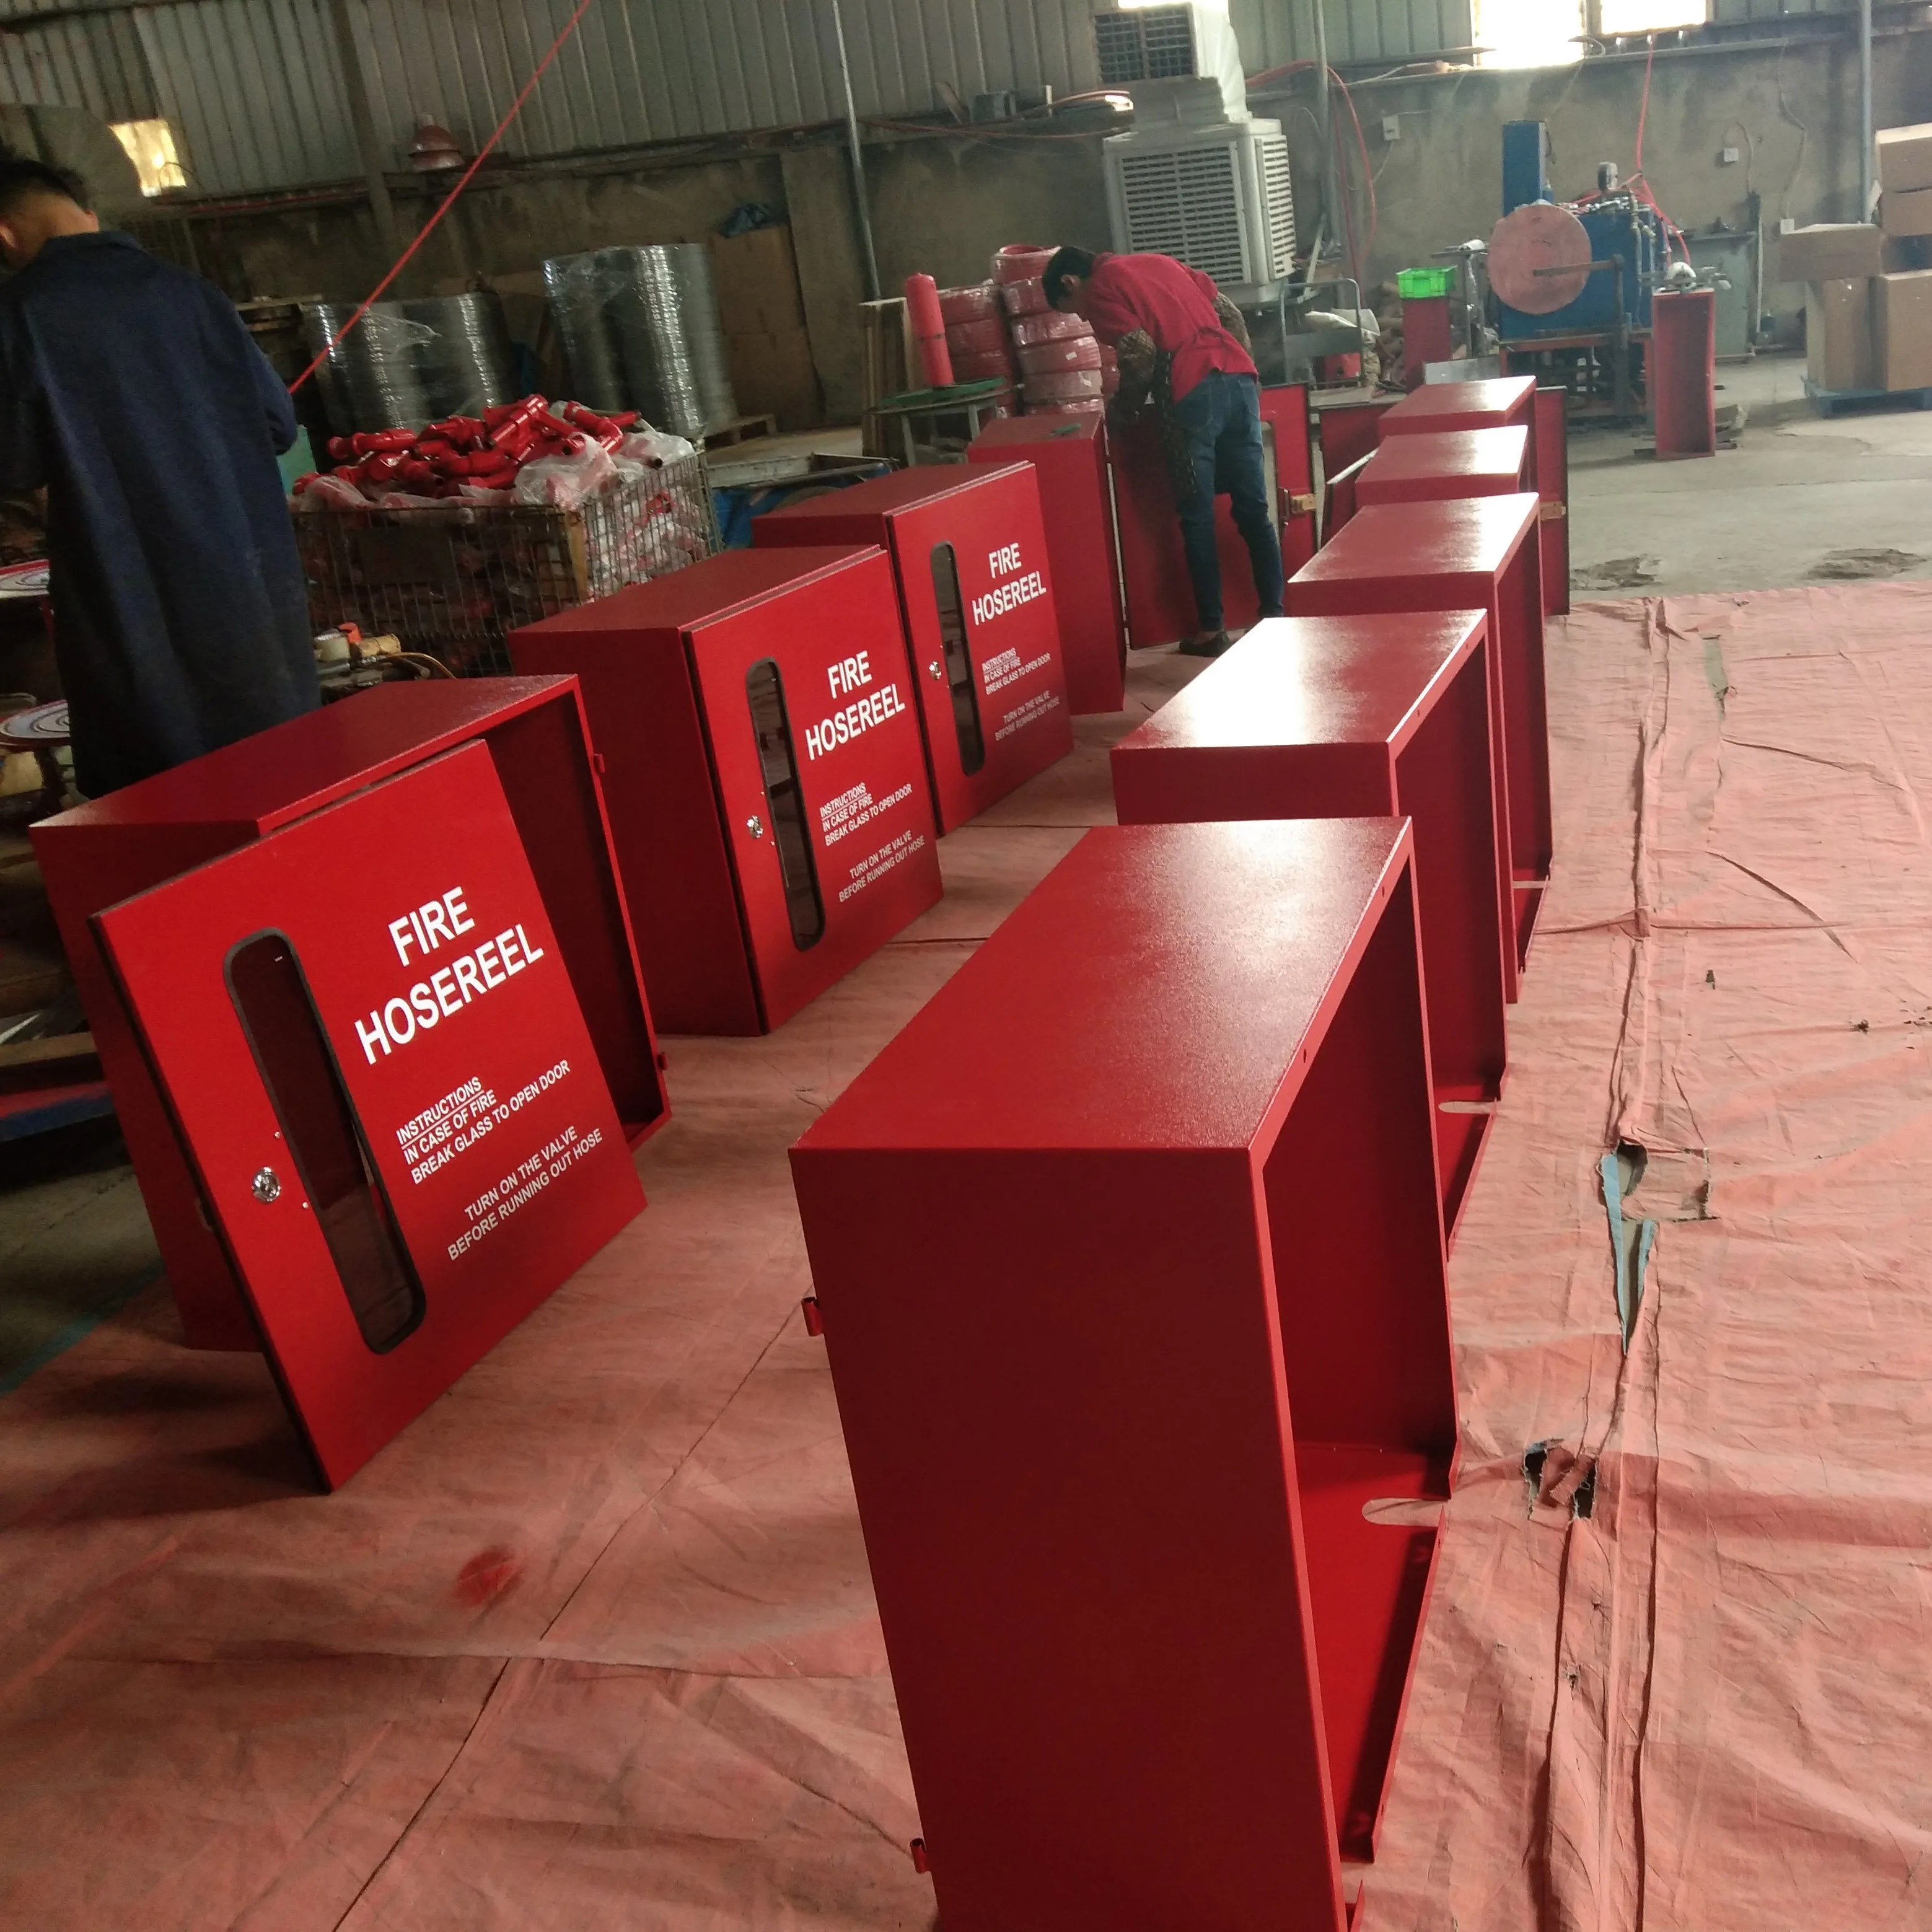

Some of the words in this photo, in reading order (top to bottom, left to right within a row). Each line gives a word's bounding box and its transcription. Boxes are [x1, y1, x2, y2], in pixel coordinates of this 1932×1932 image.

[988, 542, 1022, 579] FIRE
[972, 571, 1047, 626] HOSEREEL
[827, 650, 872, 699] FIRE
[806, 683, 905, 760] HOSEREEL
[819, 781, 866, 818] INSTRUCTIONS
[822, 820, 830, 832] IN
[830, 808, 849, 827] CASE
[849, 804, 858, 816] OF
[858, 793, 873, 810] FIRE
[825, 823, 849, 846] BREAK
[848, 810, 869, 831] GLASS
[869, 805, 879, 818] TO
[879, 794, 895, 812] OPEN
[894, 783, 913, 801] DOOR
[838, 876, 866, 902] BEFORE
[866, 856, 895, 883] RUNNING
[895, 846, 908, 863] OUT
[908, 835, 924, 854] HOSE
[849, 859, 868, 879] TURN
[869, 853, 879, 866] ON
[879, 844, 892, 859] THE
[892, 830, 912, 850] VALVE
[388, 886, 475, 967] FIRE
[354, 923, 544, 1065] HOSEREEL
[396, 1076, 481, 1144] INSTRUCTIONS
[403, 1145, 419, 1165] IN
[419, 1122, 453, 1153] CASE
[453, 1108, 469, 1129] OF
[470, 1089, 497, 1117] FIRE
[411, 1144, 455, 1185] BREAK
[454, 1116, 493, 1152] GLASS
[491, 1104, 509, 1123] TO
[509, 1081, 540, 1111] OPEN
[538, 1059, 571, 1091] DOOR
[447, 1212, 498, 1260] BEFORE
[498, 1171, 550, 1221] RUNNING
[550, 1151, 572, 1177] OUT
[573, 1128, 603, 1160] HOSE
[465, 1187, 499, 1221] TURN
[499, 1172, 518, 1194] ON
[517, 1154, 542, 1180] THE
[541, 1125, 577, 1161] VALVE
